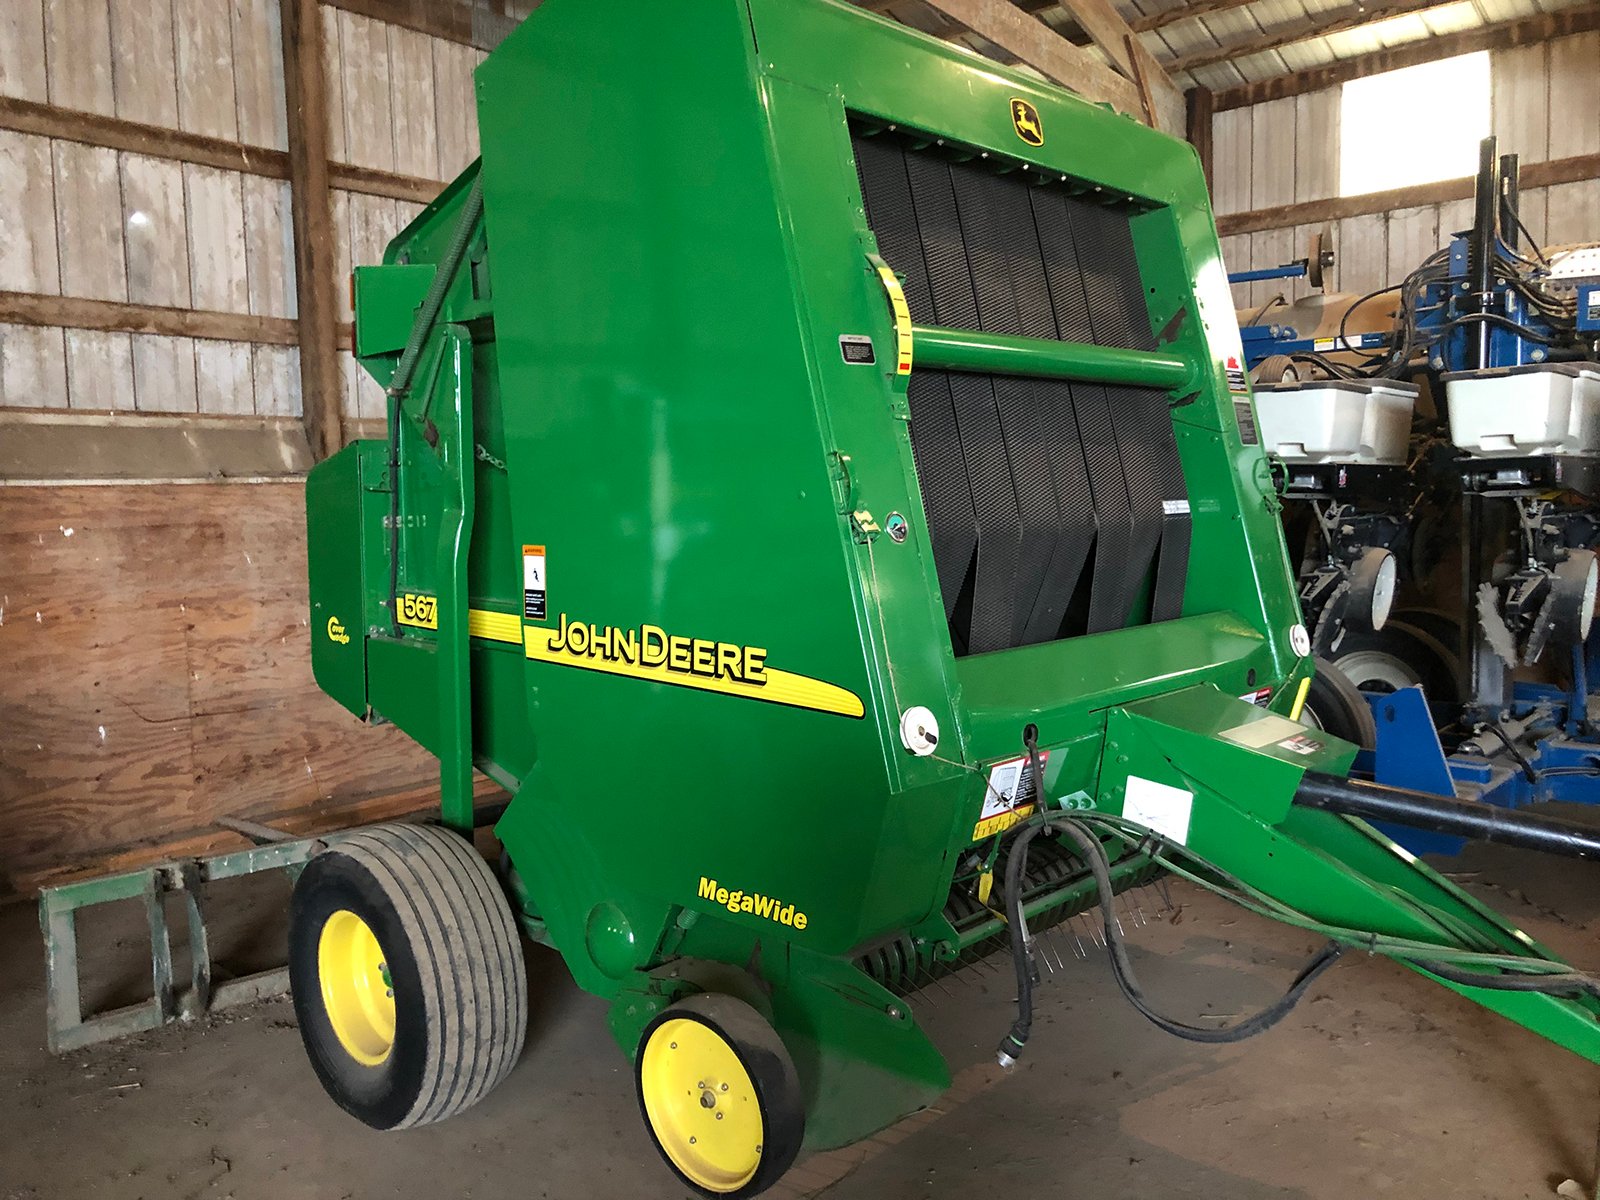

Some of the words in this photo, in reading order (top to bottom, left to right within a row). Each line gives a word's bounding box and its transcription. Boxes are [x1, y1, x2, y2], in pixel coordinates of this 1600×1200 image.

[404, 593, 438, 622] 567
[548, 612, 636, 665] JOHN
[641, 623, 768, 686] DEERE
[697, 875, 809, 931] MegaWide
